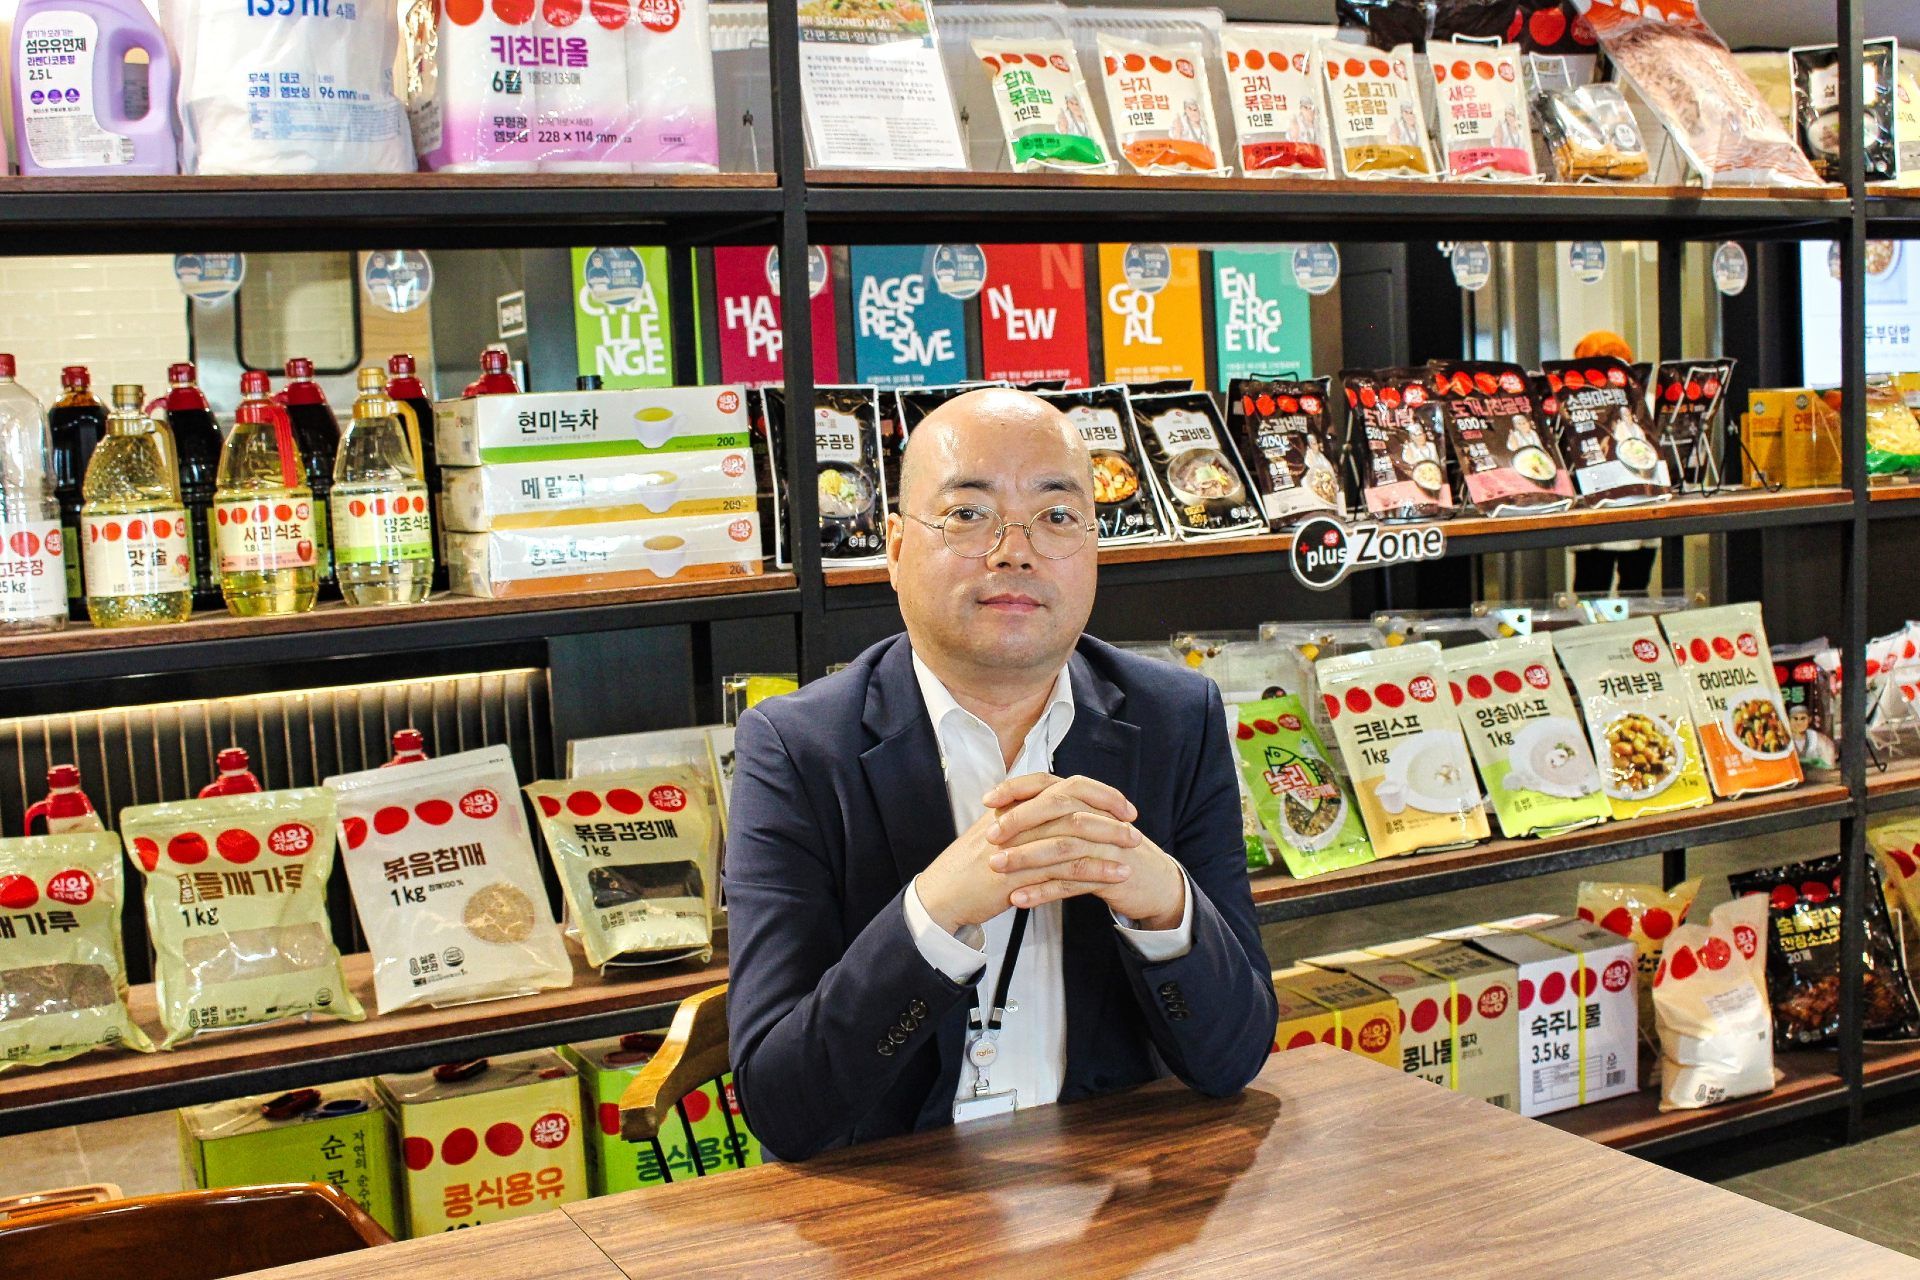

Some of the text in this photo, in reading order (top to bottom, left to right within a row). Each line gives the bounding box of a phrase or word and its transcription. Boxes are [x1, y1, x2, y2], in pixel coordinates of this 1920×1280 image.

[25, 37, 88, 54] 섬유유연제
[490, 35, 589, 68] 키친타올
[29, 69, 53, 81] 2.5 L
[279, 73, 300, 84] 데코
[492, 70, 522, 95] 6롤
[1004, 69, 1035, 88] 잡채
[1119, 77, 1151, 92] 낙지
[1241, 75, 1271, 93] 김치
[319, 86, 335, 99] 96
[1009, 87, 1054, 107] 볶음밥
[1343, 82, 1398, 99] 소불고기
[1449, 86, 1477, 102] 새우
[1123, 94, 1169, 110] 볶음밥
[1244, 95, 1287, 112] 볶음밥
[1345, 99, 1388, 116] 볶음밥
[1451, 103, 1493, 119] 볶음밥
[493, 115, 528, 129] 무형광
[1014, 105, 1042, 122] 1인분
[1128, 111, 1155, 126] 1인분
[1246, 113, 1273, 127] 1인분
[1348, 118, 1374, 132] 1인분
[1453, 120, 1479, 135] 1인분
[538, 130, 560, 143] 228
[575, 130, 593, 143] 114
[596, 132, 618, 143] mm
[858, 274, 925, 310] AGG
[1219, 267, 1256, 300] EN
[1108, 283, 1155, 320] GO
[724, 295, 776, 330] HA
[858, 303, 915, 341] RES
[1228, 299, 1282, 328] ERG
[1122, 315, 1163, 346] AL
[1225, 323, 1281, 354] ETIC
[892, 328, 955, 367] SIVE
[595, 345, 666, 377] NGE
[518, 408, 599, 435] 현미녹차
[716, 436, 736, 447] 200
[1080, 426, 1118, 441] 내장탕
[1168, 427, 1212, 444] 소갈비탕
[723, 499, 742, 511] 200
[243, 524, 302, 543] 사과식초
[383, 515, 430, 533] 양조식초
[1355, 527, 1443, 563] Zone
[1306, 543, 1347, 572] plus
[12, 580, 26, 594] kg
[1599, 671, 1664, 698] 카레분말
[1697, 667, 1759, 691] 하이라이스
[1475, 699, 1550, 728] 양송이스프
[1353, 714, 1423, 745] 크림스프
[1263, 763, 1312, 796] 노리
[574, 819, 679, 843] 볶음검정깨
[383, 842, 487, 884] 볶음참깨
[194, 864, 304, 901] 들깨가루
[1531, 1003, 1602, 1039] 숙주나물
[1402, 1038, 1452, 1073] 콩나물
[636, 1132, 750, 1183] 콩식용유
[443, 1166, 566, 1219] 콩식용유
